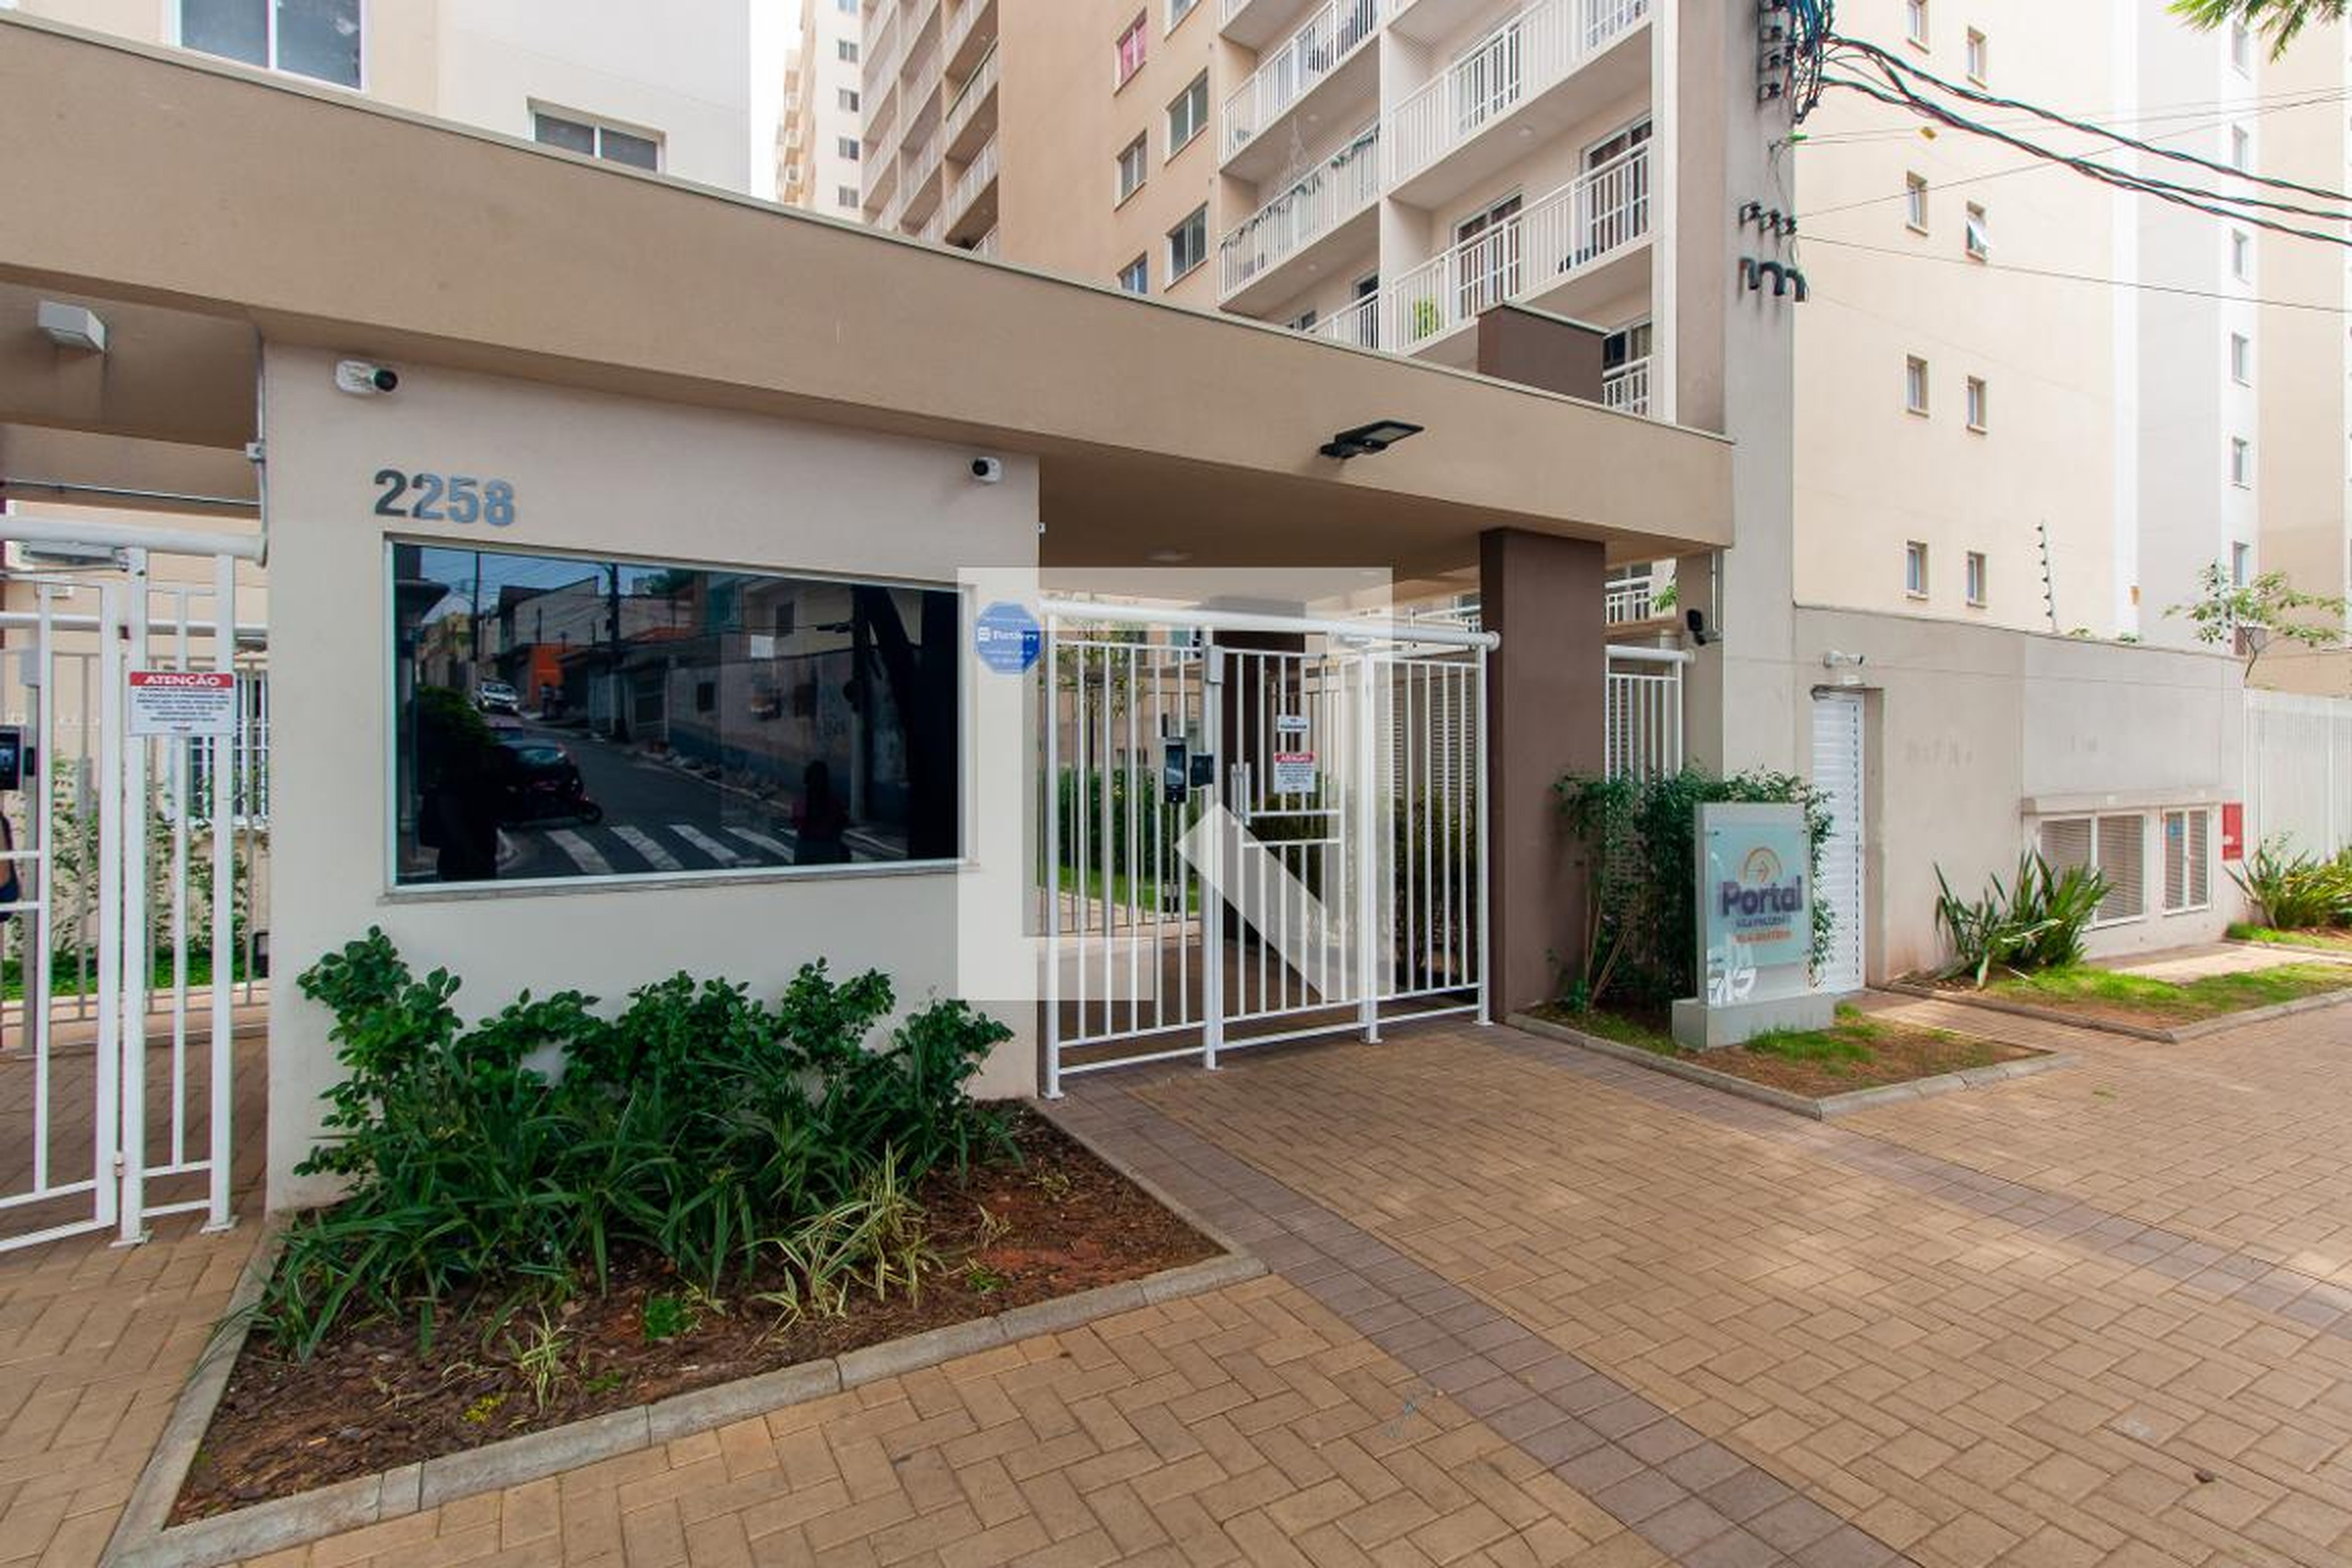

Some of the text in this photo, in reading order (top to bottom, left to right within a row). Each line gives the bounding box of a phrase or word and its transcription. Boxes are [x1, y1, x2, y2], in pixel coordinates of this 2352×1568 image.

[374, 469, 515, 527] 2258
[144, 673, 221, 686] ATENÇÃO
[1722, 875, 1803, 916] Portal
